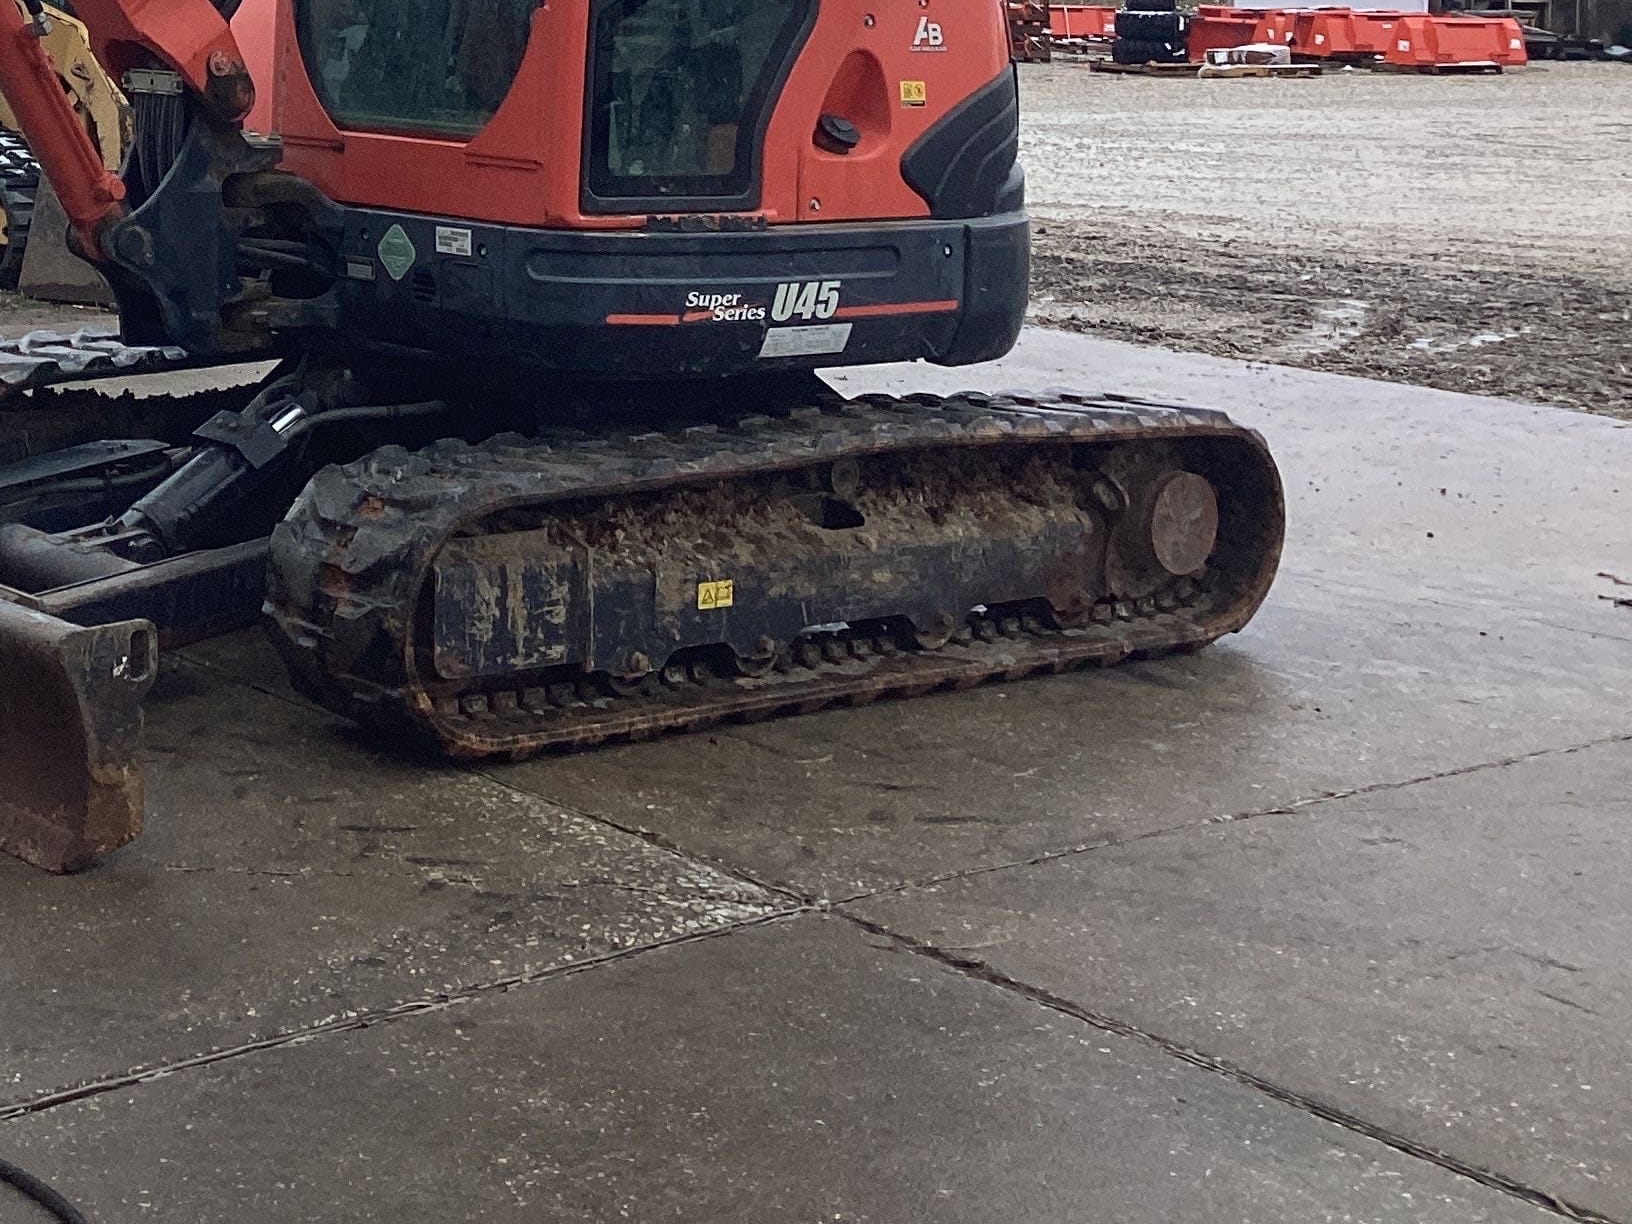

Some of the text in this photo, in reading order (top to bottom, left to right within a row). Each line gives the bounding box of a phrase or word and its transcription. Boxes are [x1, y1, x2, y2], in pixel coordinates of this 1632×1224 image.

[912, 16, 944, 46] AB
[685, 291, 742, 311] Super
[712, 303, 766, 322] Series
[771, 280, 842, 322] U45
